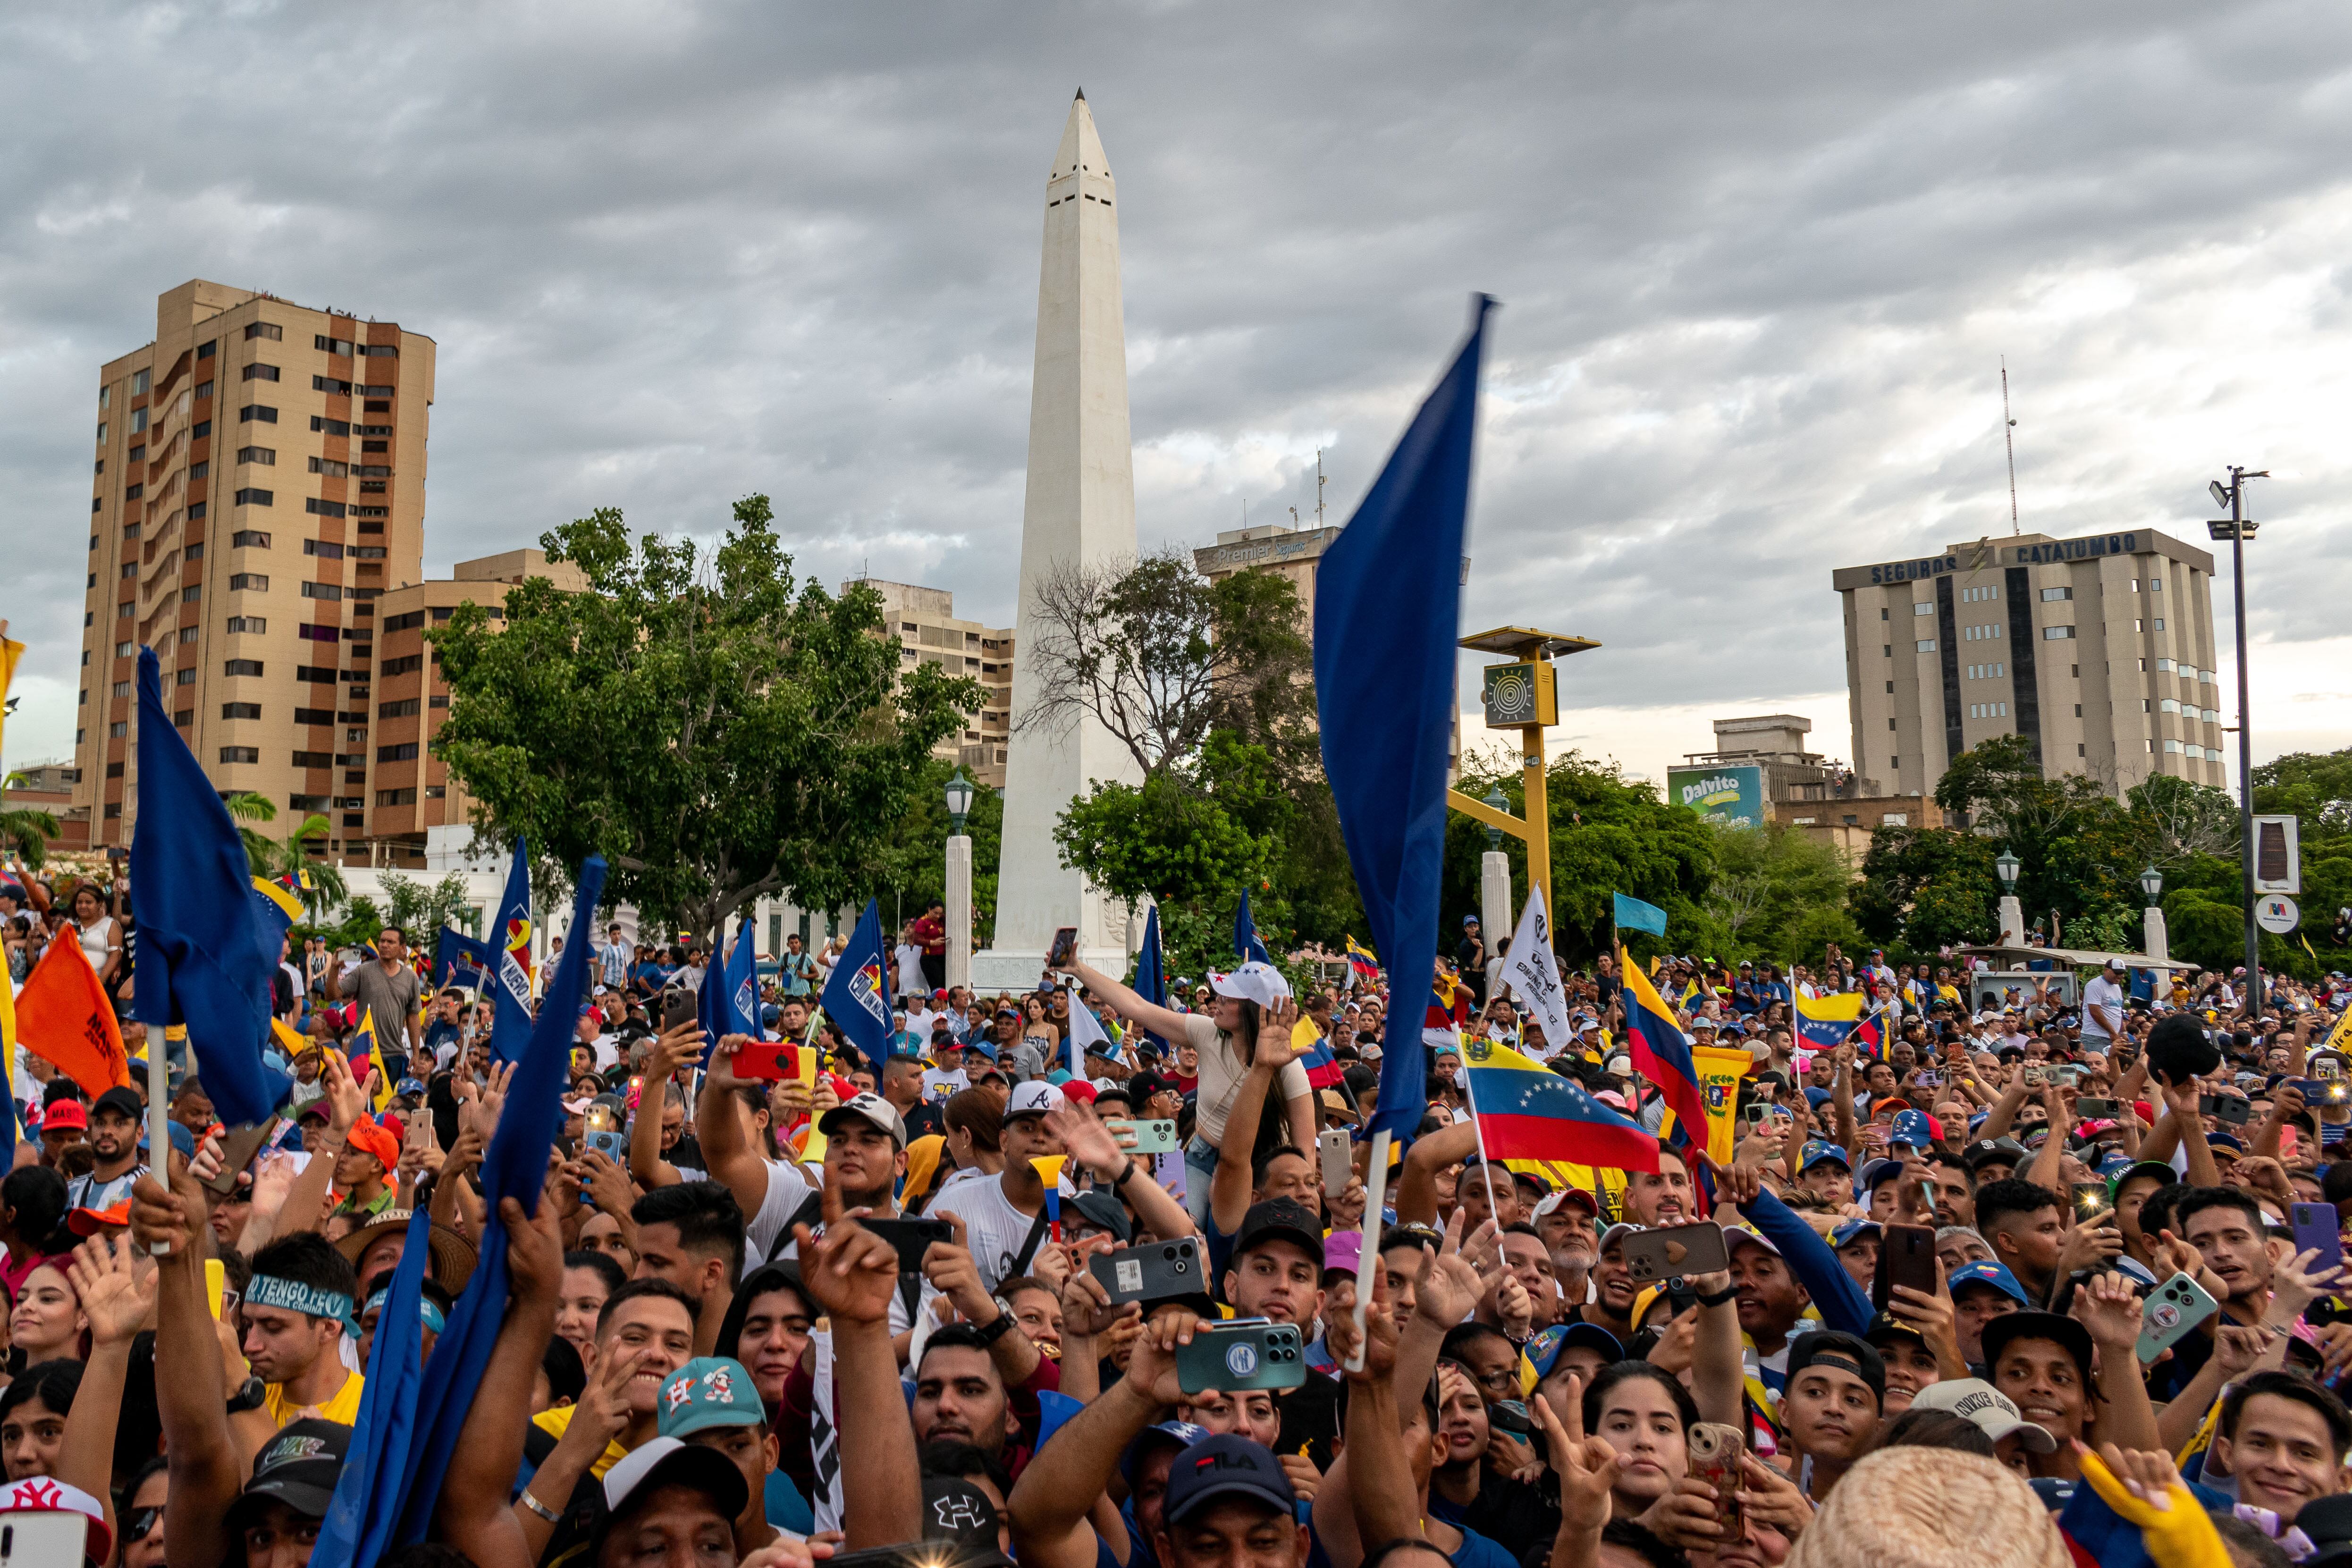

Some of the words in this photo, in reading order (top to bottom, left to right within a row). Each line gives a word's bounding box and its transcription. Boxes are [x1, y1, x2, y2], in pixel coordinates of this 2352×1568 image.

[1218, 544, 1271, 564] Premier
[1276, 541, 1307, 560] Seguros
[1871, 556, 1957, 583] SEGUROS
[2017, 533, 2136, 563] CATATUMBO
[1682, 776, 1739, 805] Dalvito
[260, 1276, 308, 1303] TENGO
[310, 1288, 326, 1307] FE
[292, 1301, 322, 1315] CORINA
[1955, 1391, 1994, 1417] NIKE
[1995, 1394, 2017, 1419] AIR
[1196, 1451, 1258, 1476] FILA
